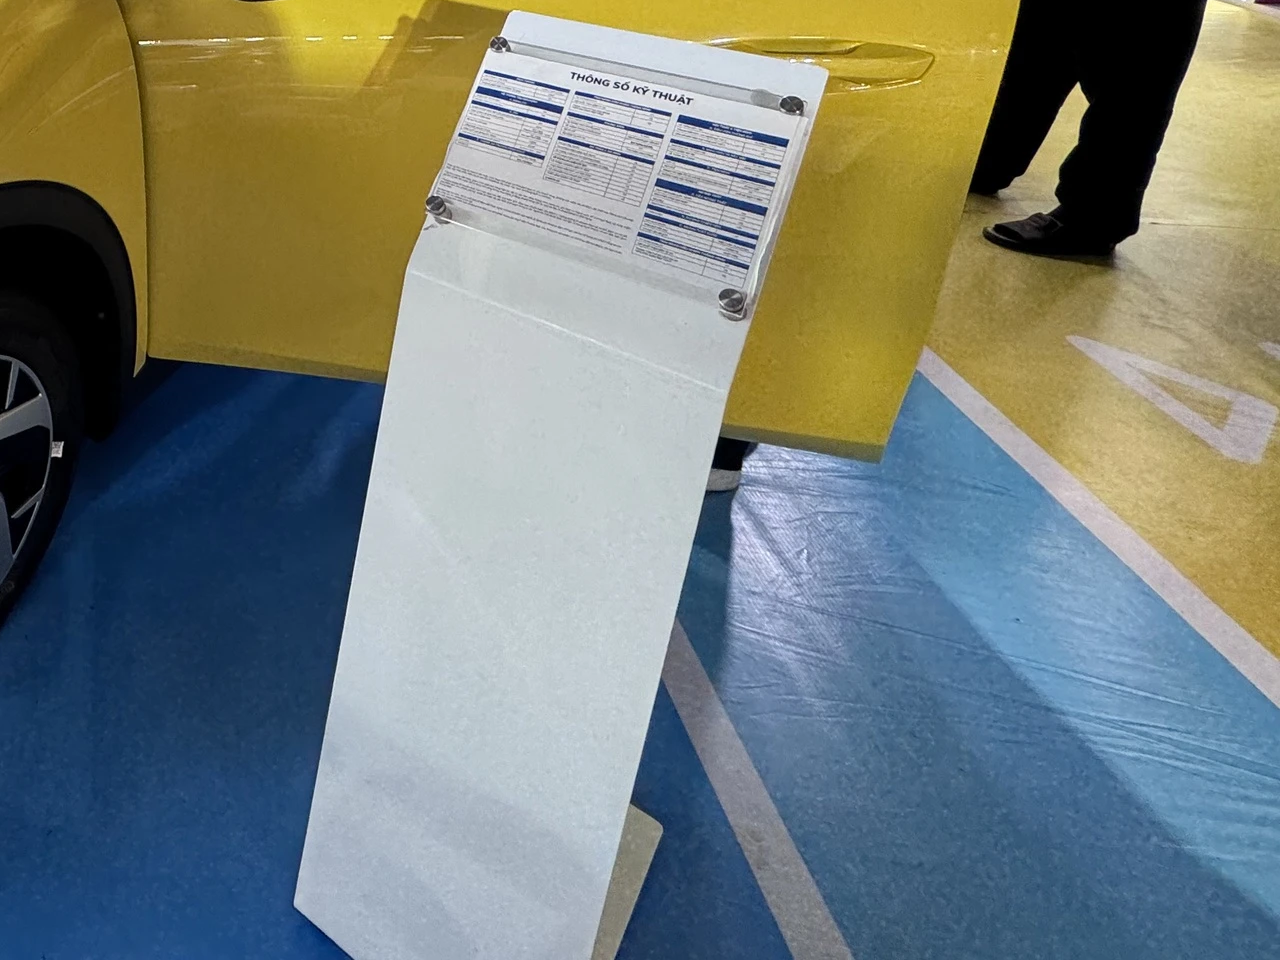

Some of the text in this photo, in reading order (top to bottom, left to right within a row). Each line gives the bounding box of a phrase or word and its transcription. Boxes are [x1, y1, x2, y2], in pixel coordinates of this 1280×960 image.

[570, 71, 695, 106] THÔNG SỐ KỸ THUẬT
